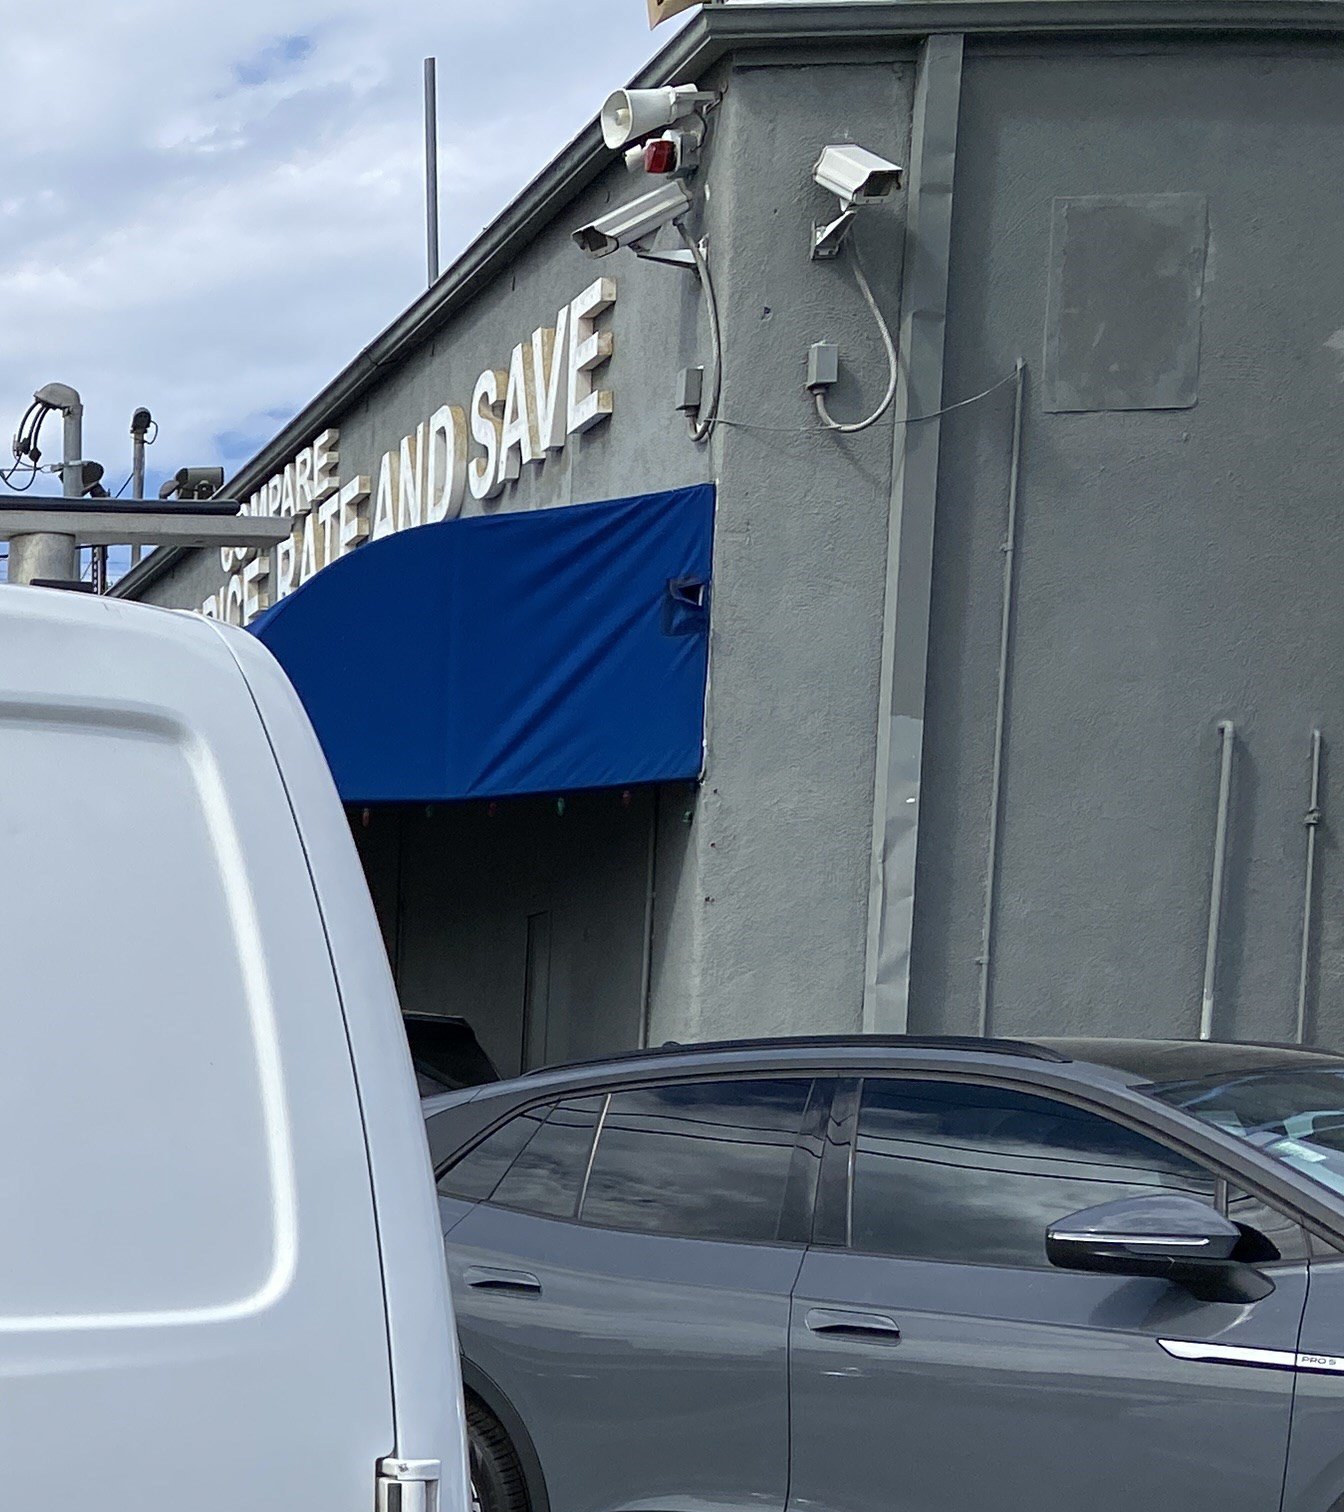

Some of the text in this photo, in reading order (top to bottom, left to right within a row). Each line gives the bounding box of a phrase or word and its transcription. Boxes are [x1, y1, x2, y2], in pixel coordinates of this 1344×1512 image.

[197, 277, 617, 627] ICE RATE AND SAVE
[1302, 1356, 1326, 1365] PRO
